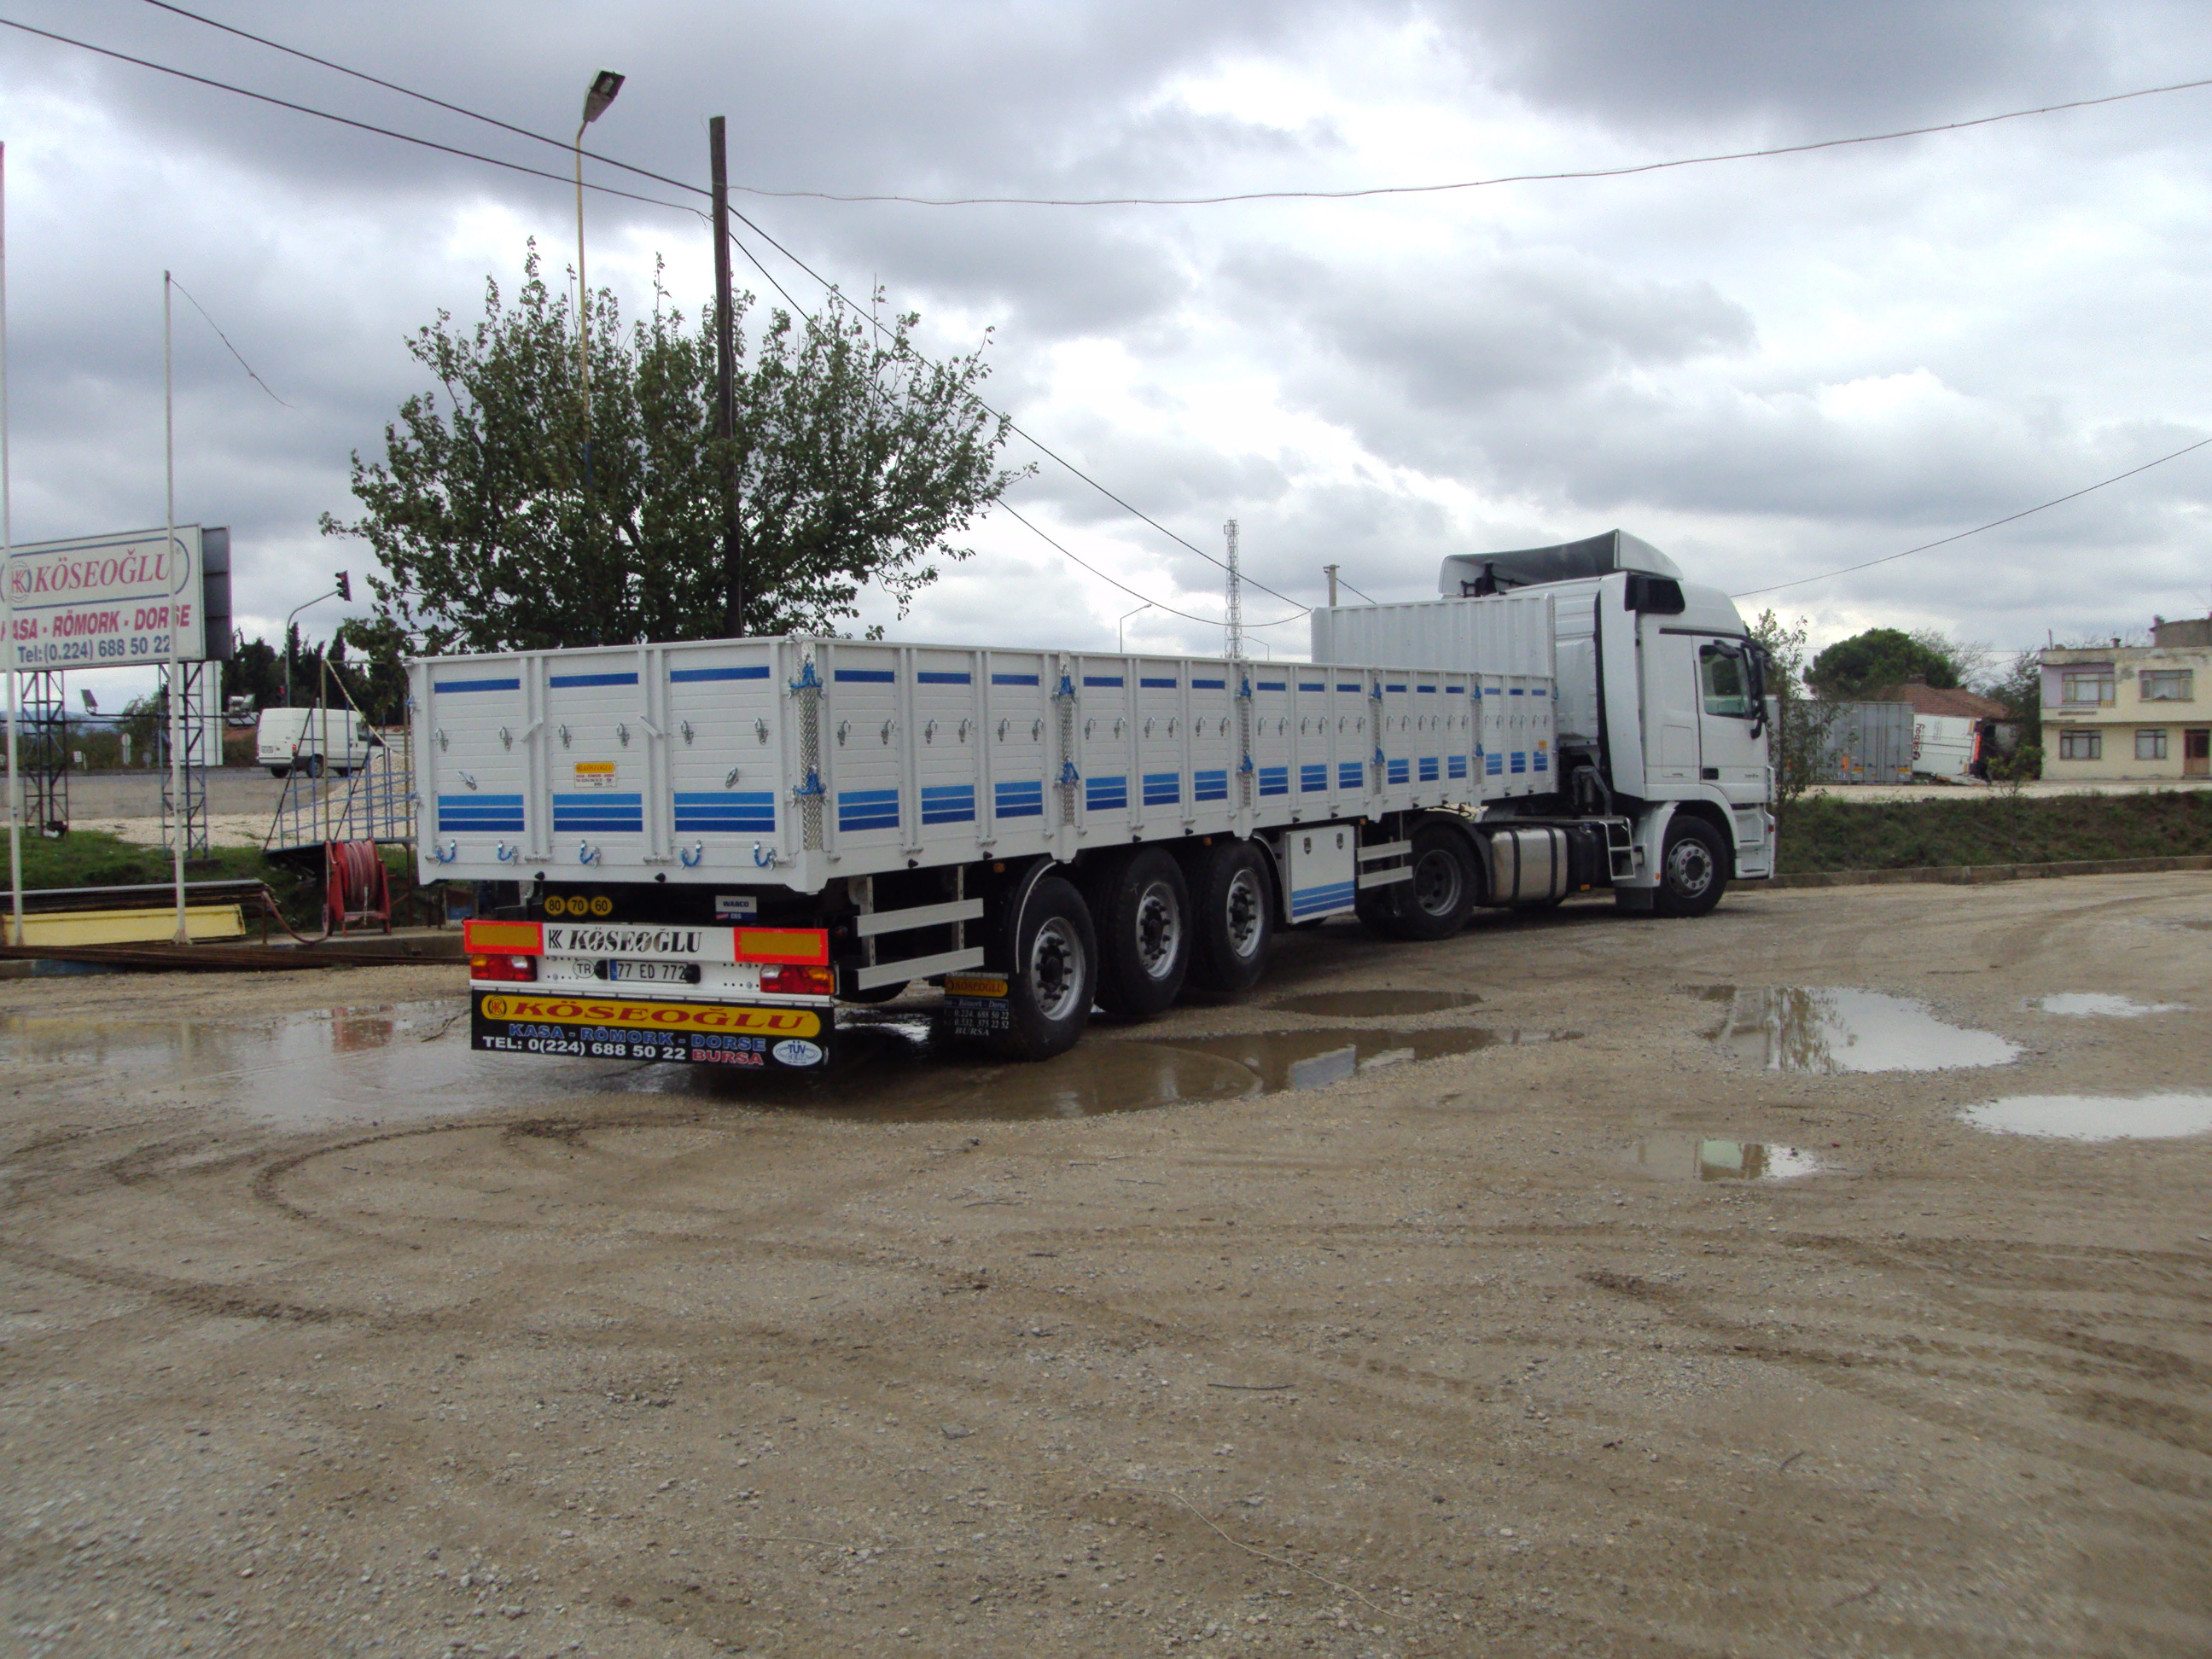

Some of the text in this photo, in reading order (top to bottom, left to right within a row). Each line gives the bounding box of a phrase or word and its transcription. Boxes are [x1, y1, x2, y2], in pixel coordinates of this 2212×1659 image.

[33, 549, 170, 593] KÖSEOĞLU
[52, 609, 120, 637] RÖMORK
[98, 639, 125, 658] 688
[131, 637, 148, 655] 50
[154, 635, 170, 654] 22
[549, 899, 562, 911] 80
[571, 899, 585, 911] 70
[595, 899, 608, 911] 60
[568, 927, 702, 953] KÖSEOĞLU
[576, 963, 591, 975] TR
[617, 963, 632, 978] 77
[640, 963, 655, 979] ED
[513, 1000, 804, 1029] KÖSEOĞLU
[509, 1024, 564, 1039] KASA
[580, 1026, 674, 1045] RÖMORK
[690, 1034, 766, 1051] DORSE
[955, 1027, 989, 1036] BURSA
[482, 1036, 765, 1065] TEL: 0(224) 688 50 22 BURSA
[788, 1040, 806, 1054] TÜV
